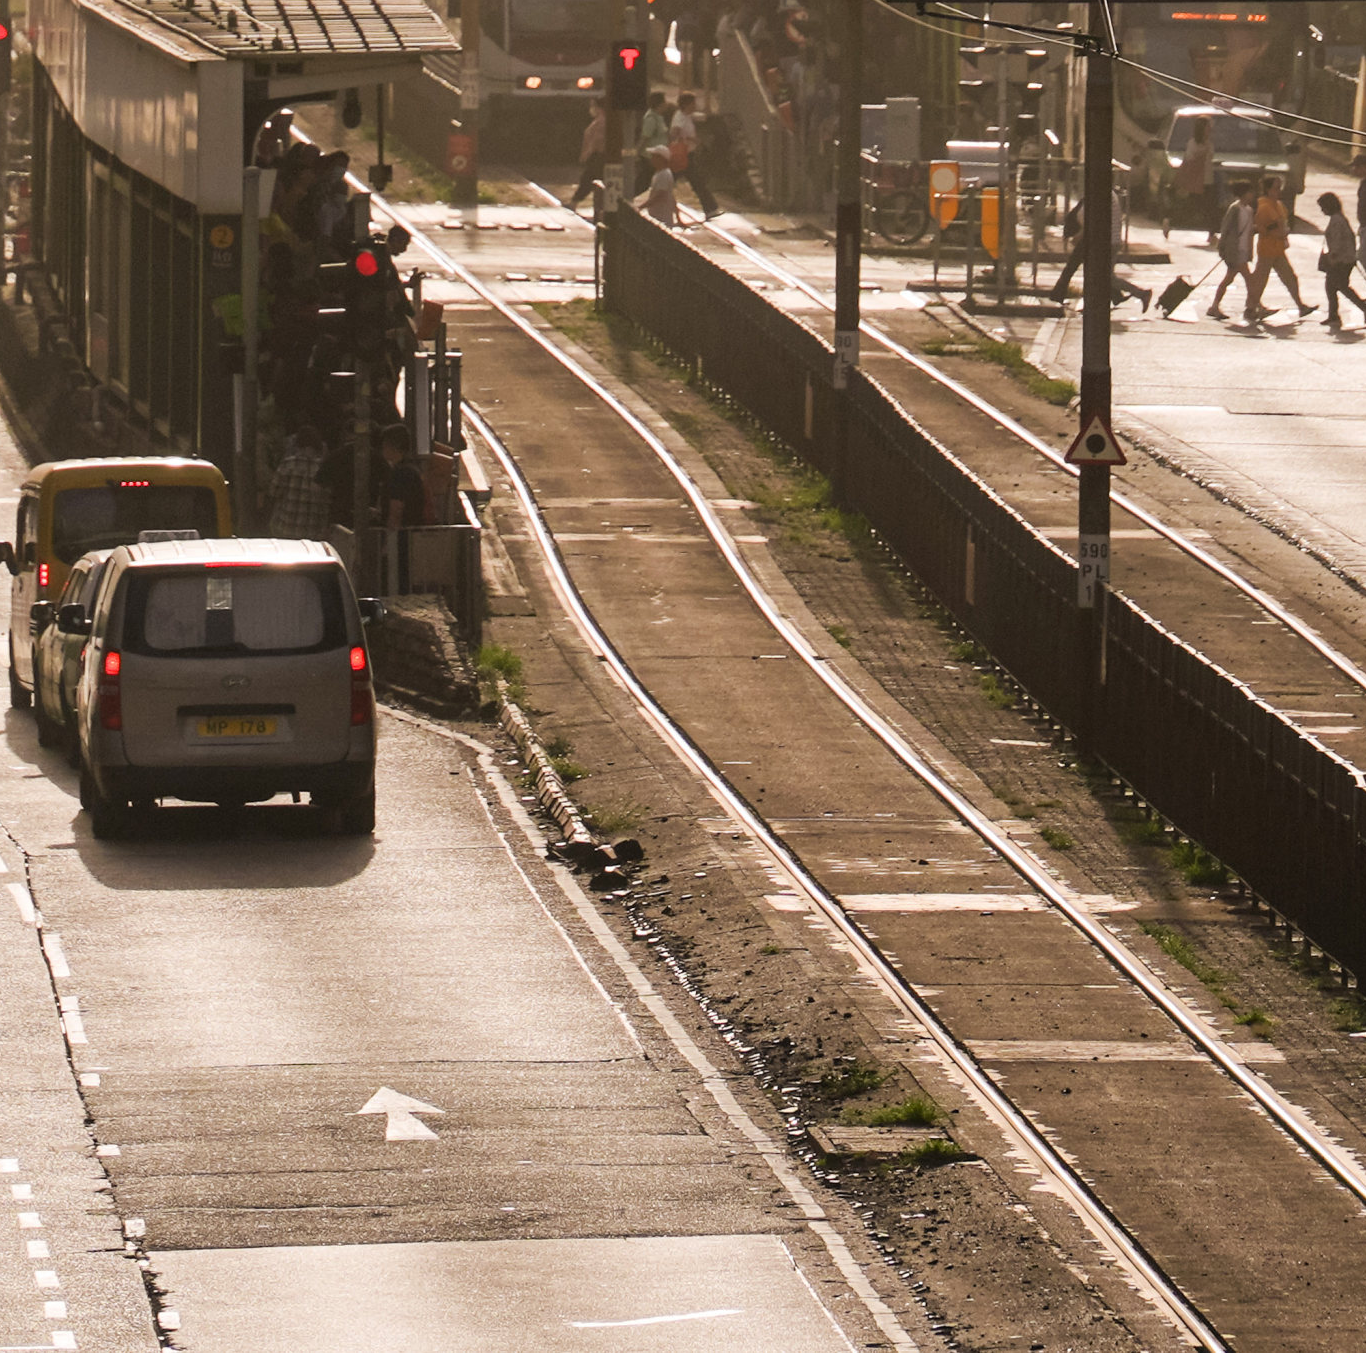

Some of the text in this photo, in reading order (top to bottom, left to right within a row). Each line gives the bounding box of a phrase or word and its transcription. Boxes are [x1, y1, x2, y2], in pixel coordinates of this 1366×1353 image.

[1080, 543, 1108, 559] 590
[1082, 564, 1105, 579] PL
[206, 720, 267, 734] MP 178
